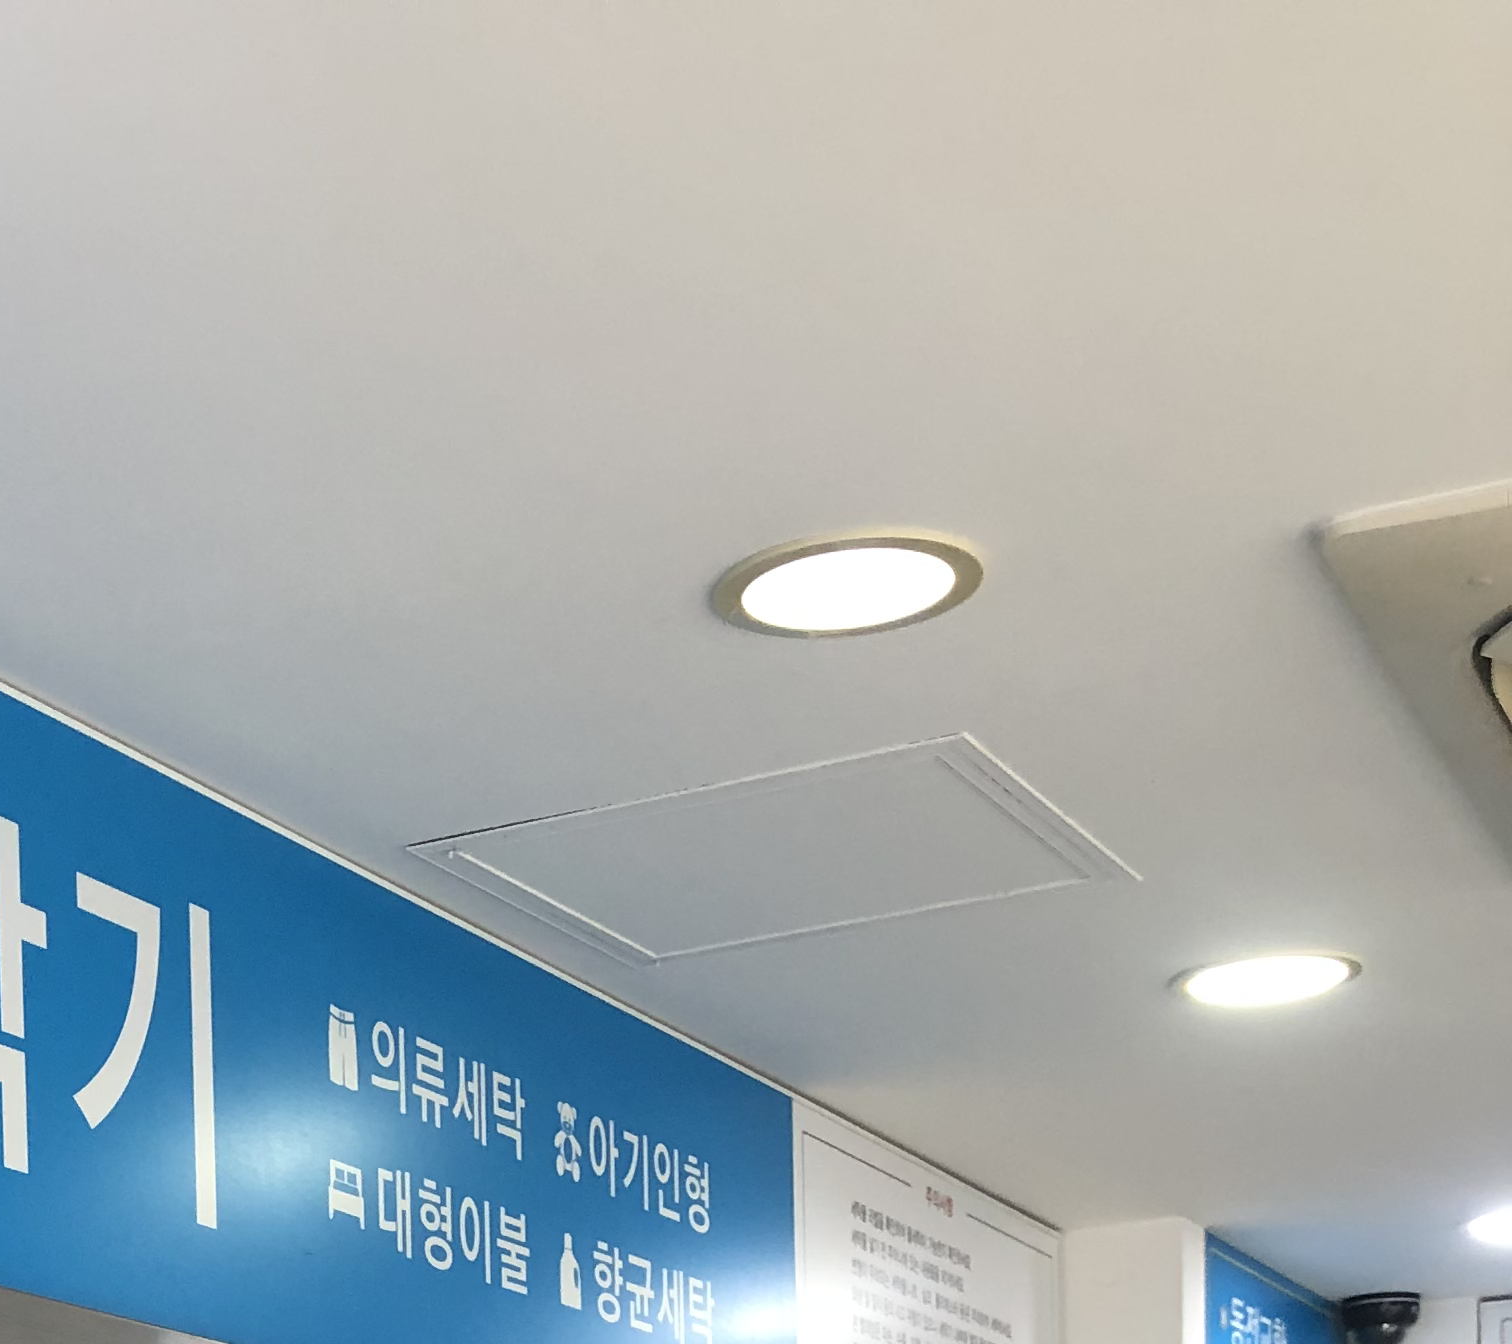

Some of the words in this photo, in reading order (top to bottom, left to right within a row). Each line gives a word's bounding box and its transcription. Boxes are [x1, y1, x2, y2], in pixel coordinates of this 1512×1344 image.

[371, 1021, 525, 1160] 의류세탁
[589, 1115, 711, 1234] 아기인형
[377, 1167, 531, 1295] 대형이불
